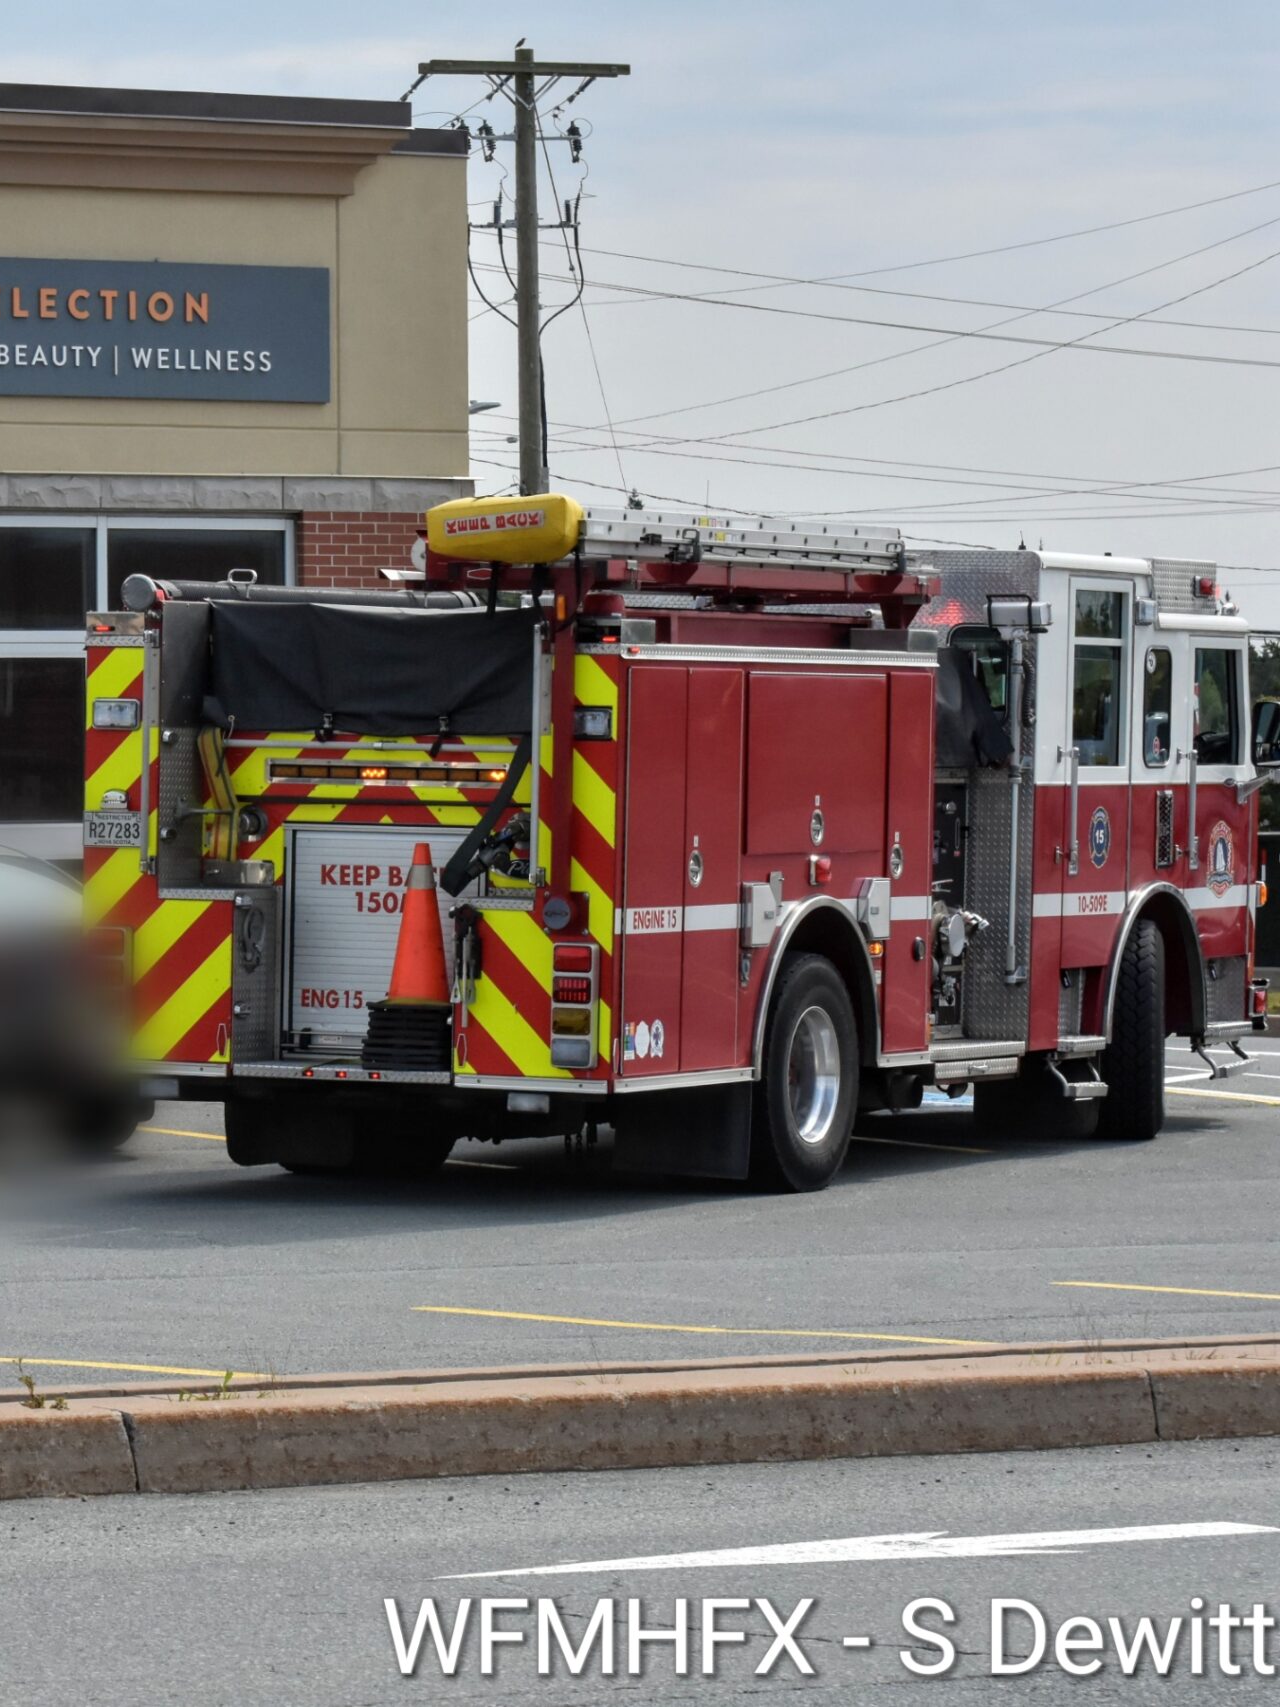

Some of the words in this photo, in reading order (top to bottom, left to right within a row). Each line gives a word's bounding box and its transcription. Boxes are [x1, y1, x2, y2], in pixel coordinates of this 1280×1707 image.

[131, 347, 273, 373] WELLNESS
[447, 517, 490, 534] KEEP
[495, 512, 539, 528] BACK
[89, 822, 140, 839] R27283
[1095, 829, 1104, 844] 15
[320, 864, 380, 887] KEEP
[355, 892, 407, 914] 150
[1078, 895, 1107, 913] 10-509E
[633, 910, 665, 930] ENGINE
[667, 910, 677, 928] 15
[301, 988, 339, 1009] ENG
[344, 989, 363, 1010] 15
